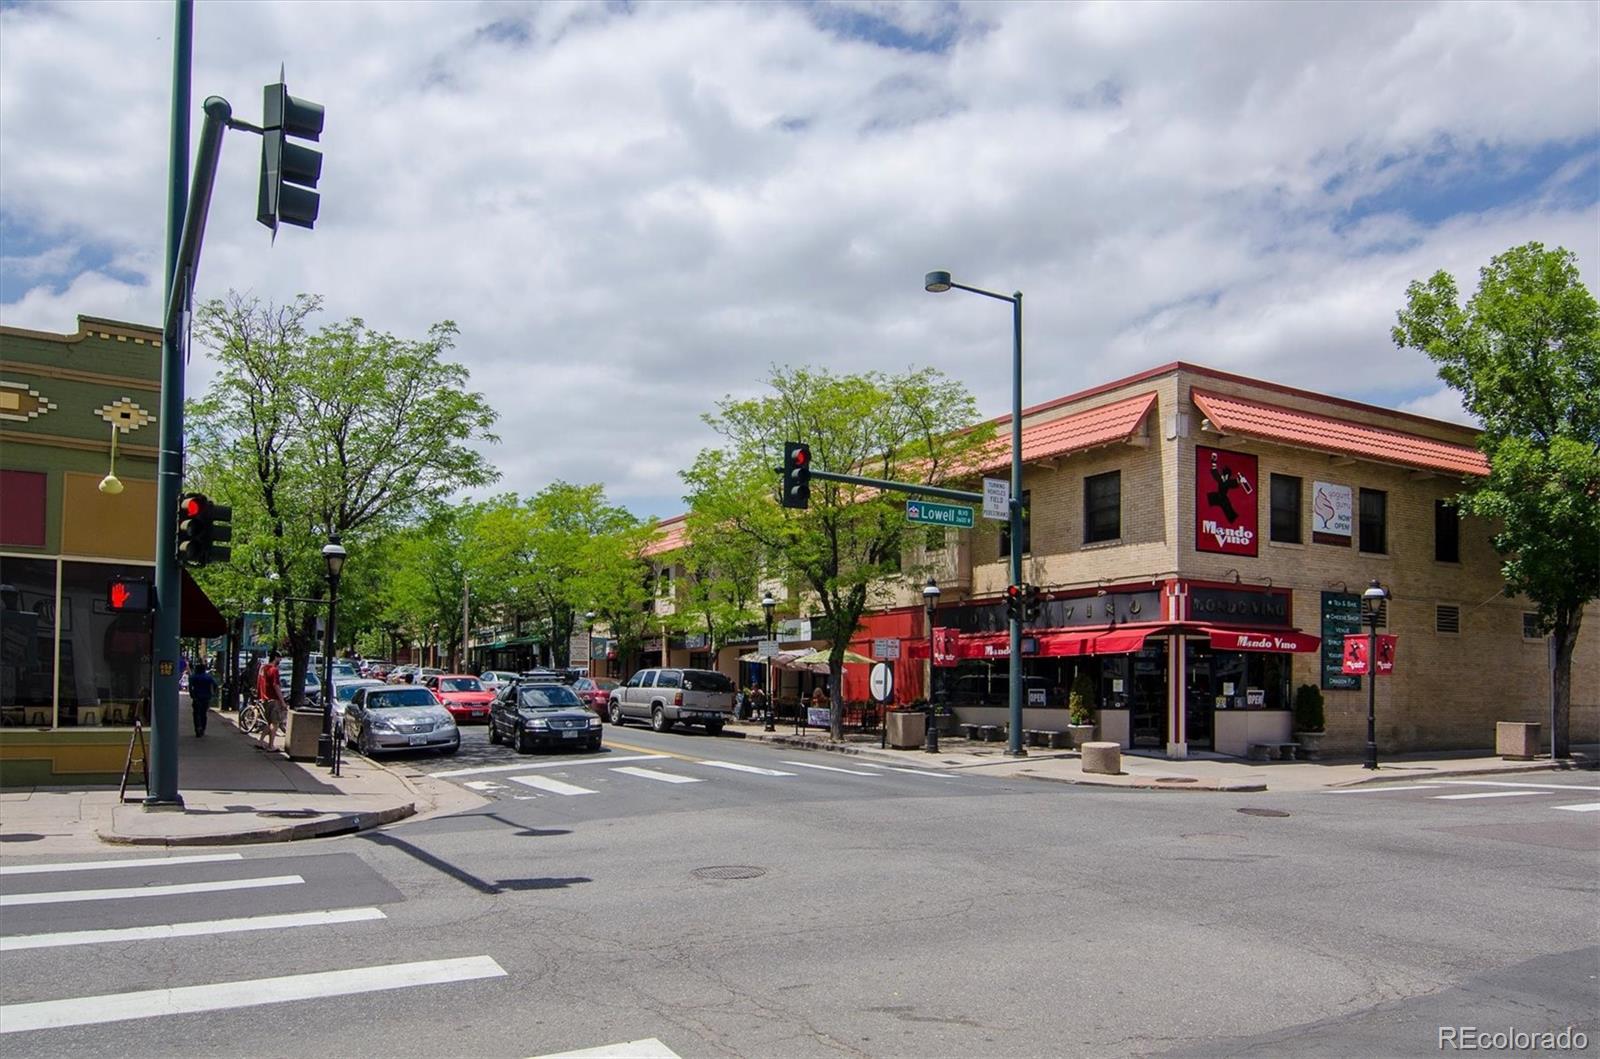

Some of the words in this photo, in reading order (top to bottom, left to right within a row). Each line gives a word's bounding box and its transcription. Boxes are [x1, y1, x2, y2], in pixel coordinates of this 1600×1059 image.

[921, 505, 955, 521] Lowell
[1215, 534, 1250, 548] Vino
[1274, 637, 1297, 649] Vino
